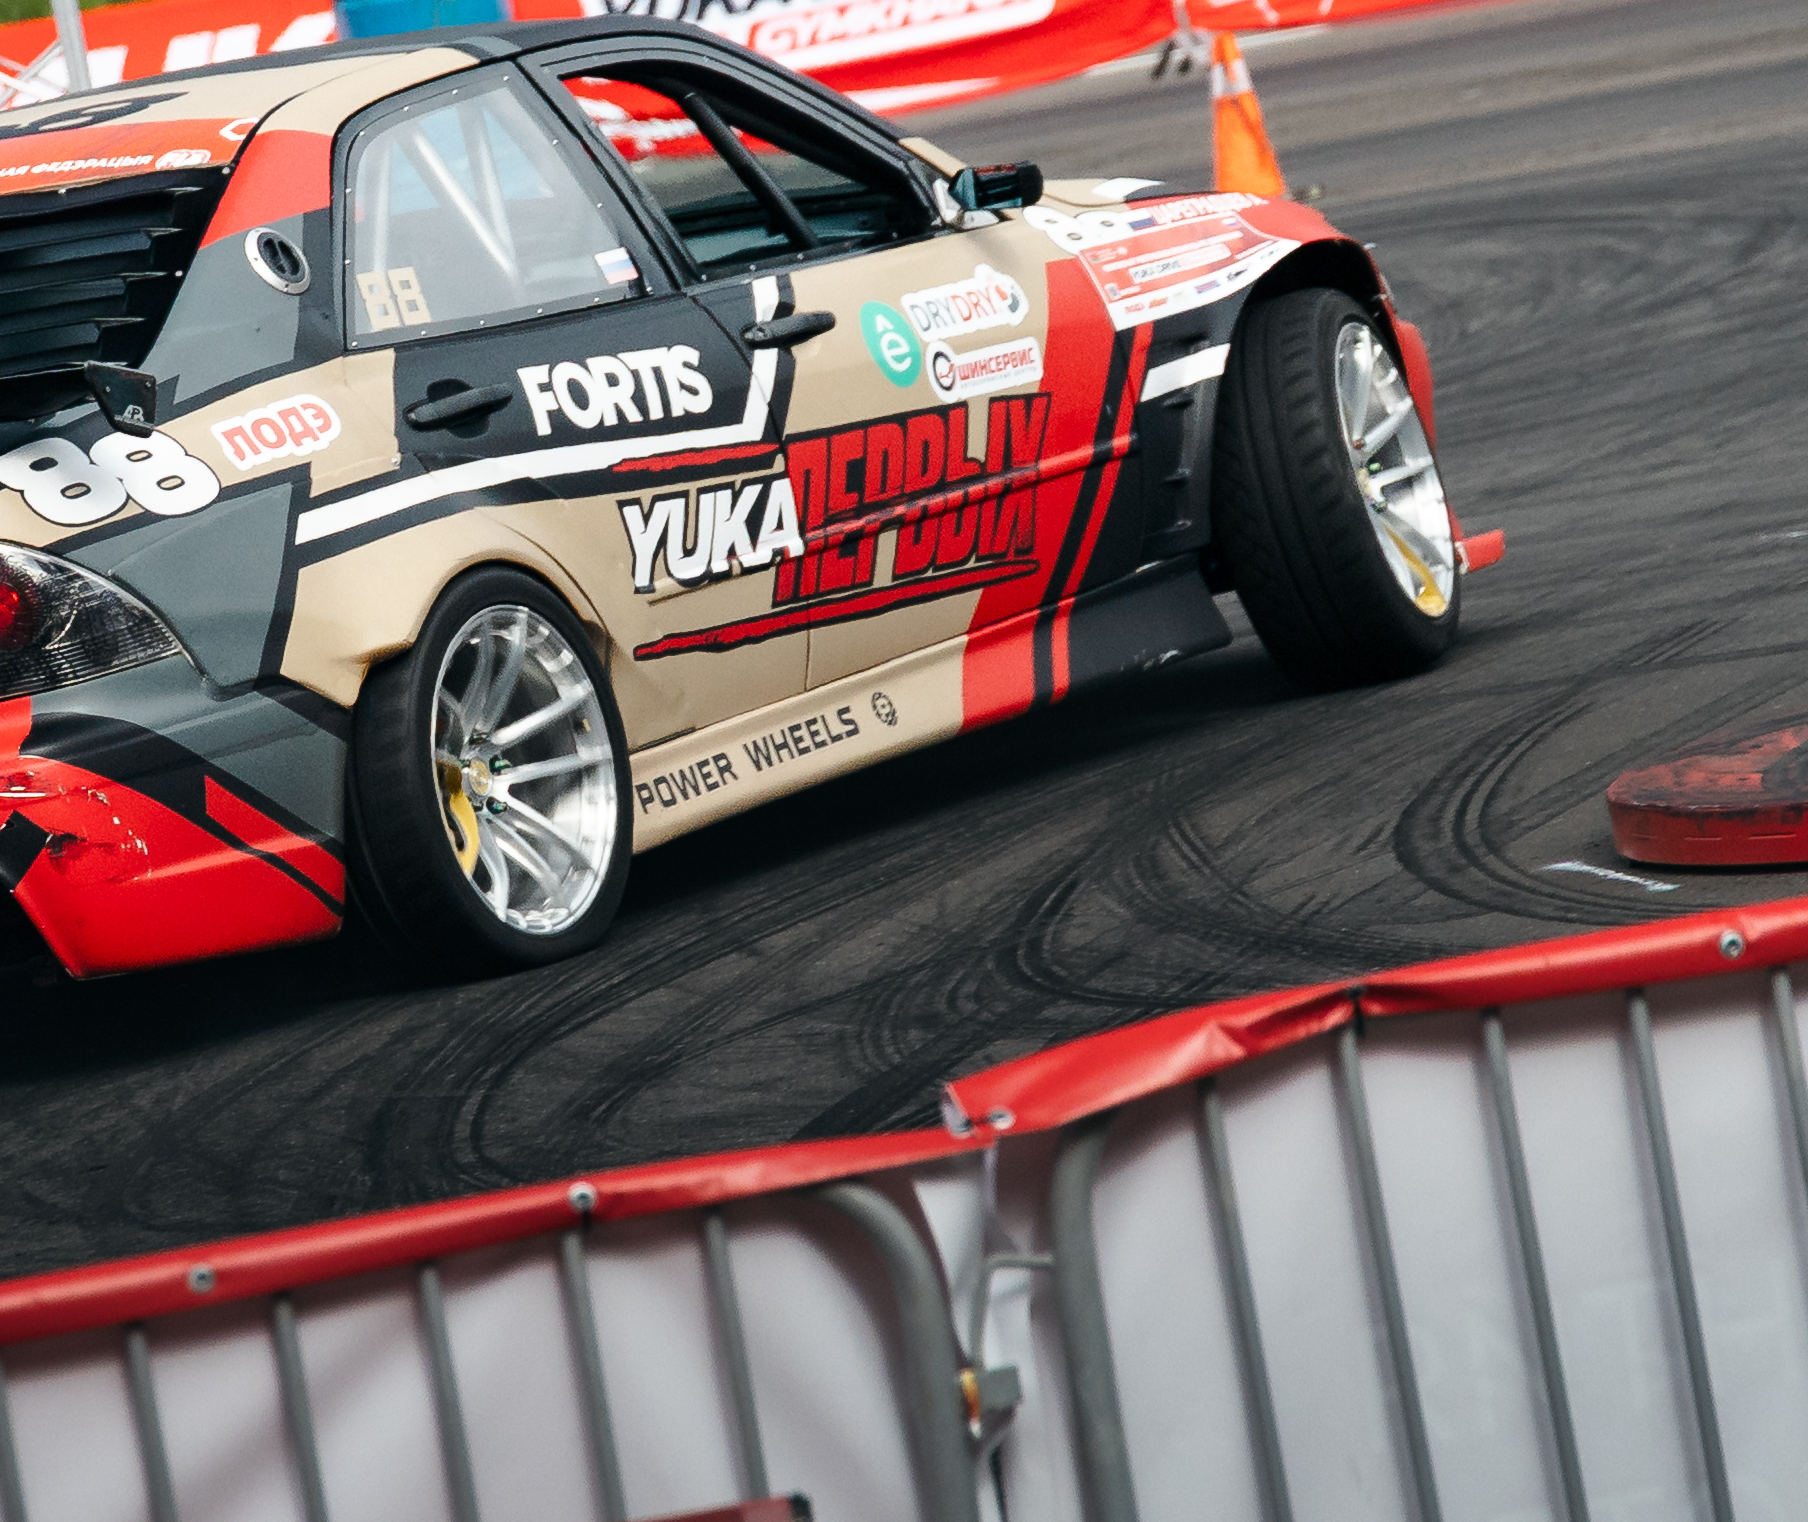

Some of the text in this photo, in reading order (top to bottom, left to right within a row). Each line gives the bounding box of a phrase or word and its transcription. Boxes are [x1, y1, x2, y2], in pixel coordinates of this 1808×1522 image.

[355, 266, 433, 331] 88
[910, 286, 999, 332] DRYDRY
[516, 344, 714, 438] FORTIS
[957, 347, 1036, 381] ШИНСЕРВИС
[220, 401, 334, 462] ЛОДЭ
[621, 476, 807, 594] YUKA
[636, 704, 861, 816] POWER WHEELS
